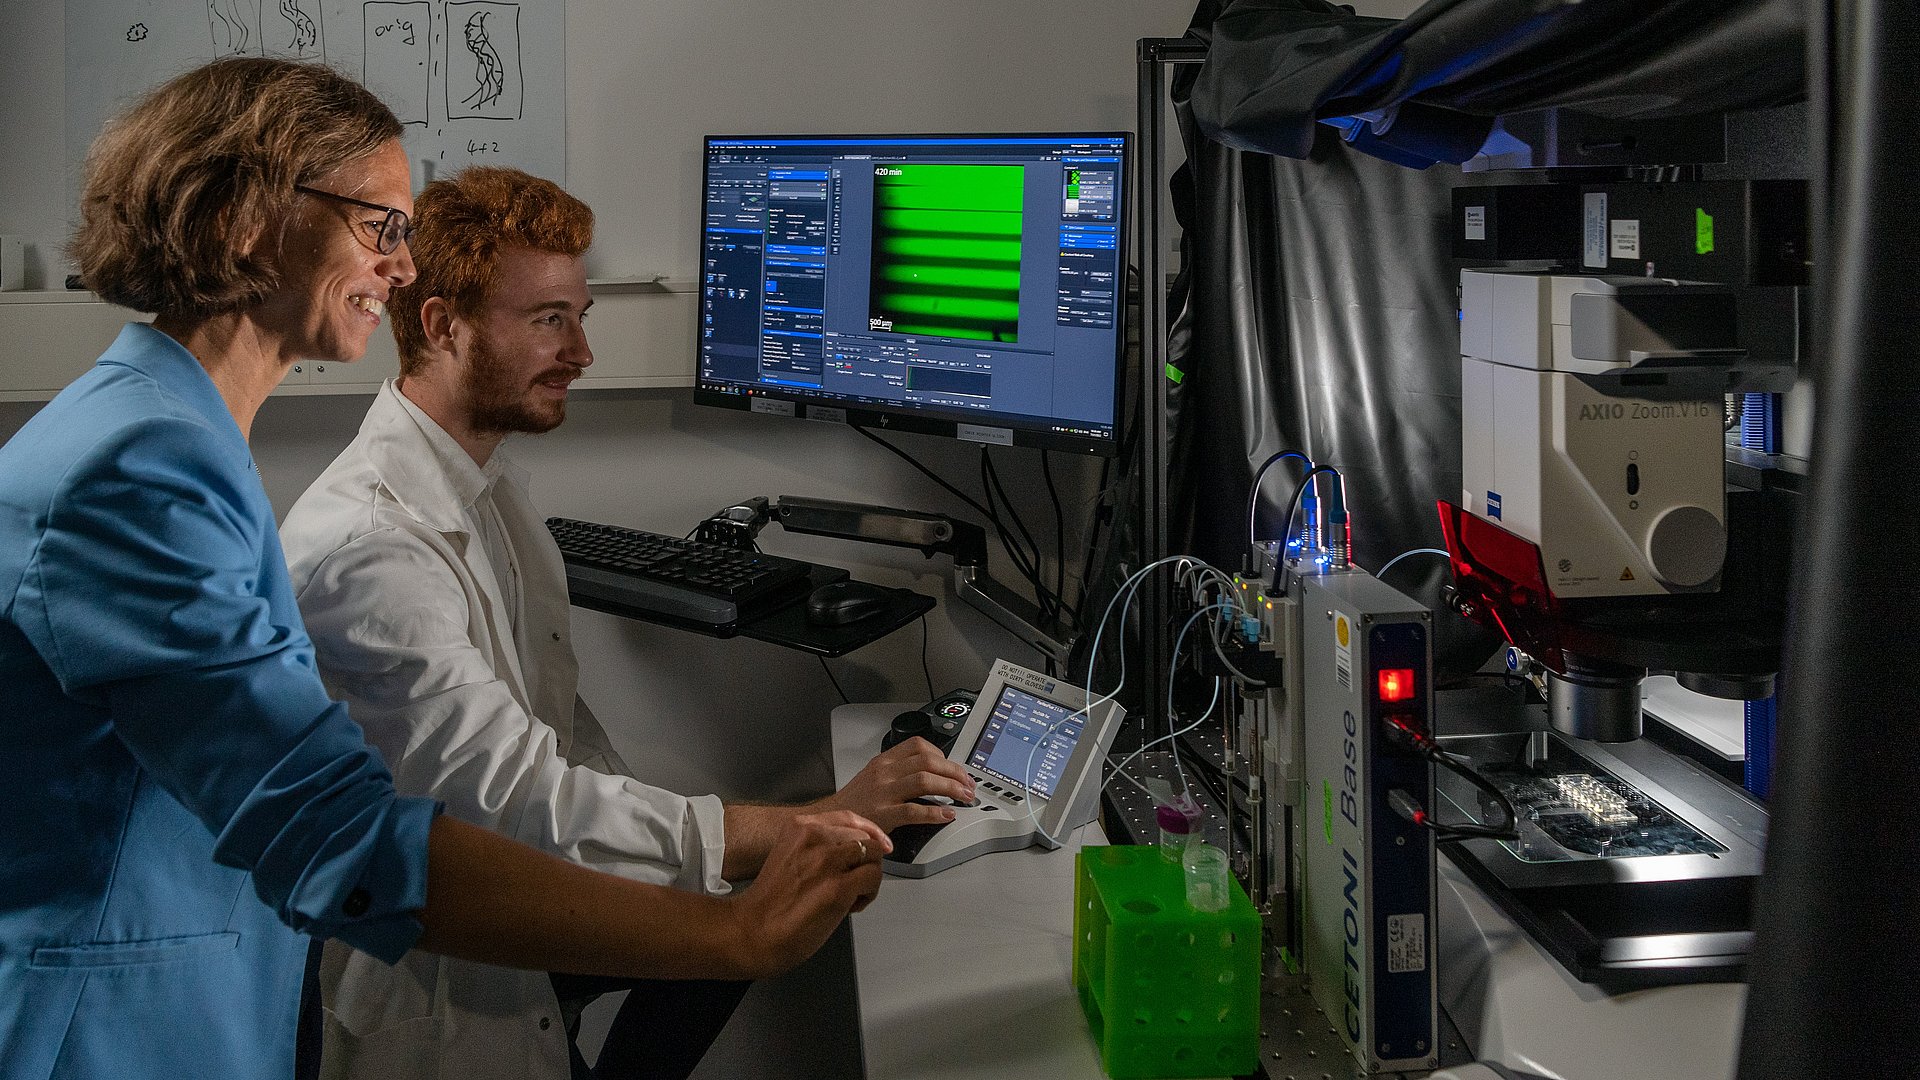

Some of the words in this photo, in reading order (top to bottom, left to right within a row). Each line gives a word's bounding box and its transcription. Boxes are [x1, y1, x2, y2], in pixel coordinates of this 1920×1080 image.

[375, 19, 416, 45] orig
[1579, 403, 1624, 420] AXIO
[1631, 402, 1709, 420] Zoom.V16
[997, 670, 1009, 678] WITH
[1009, 674, 1024, 683] DIRTY
[1026, 673, 1046, 685] OPERATE
[1340, 709, 1358, 828] Base
[1342, 847, 1362, 1044] CETONI
